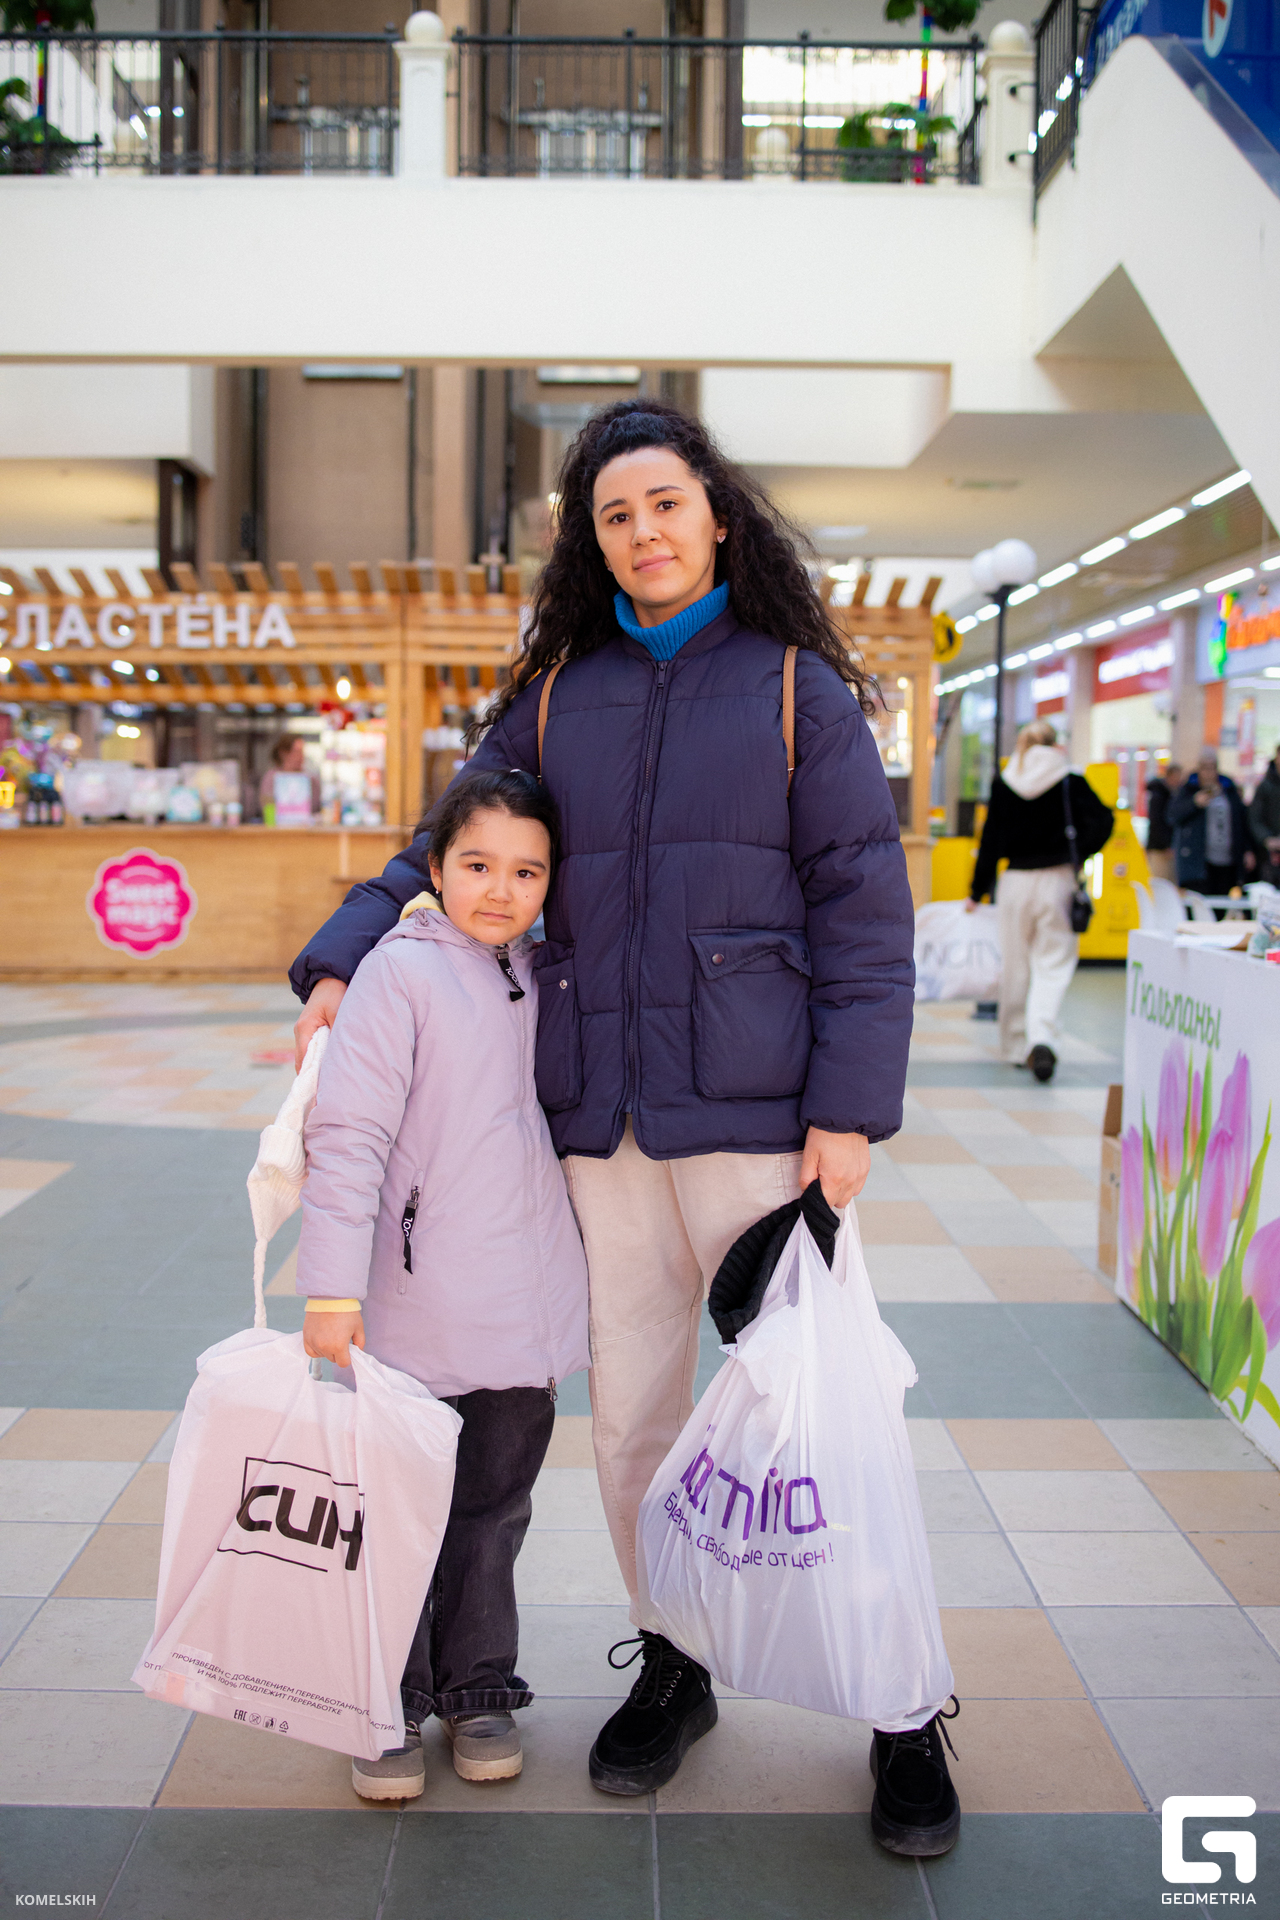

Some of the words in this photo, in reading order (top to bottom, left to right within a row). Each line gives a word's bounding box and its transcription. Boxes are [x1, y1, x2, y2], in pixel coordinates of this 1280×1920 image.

[0, 594, 297, 649] ЛАСТЁНА
[1131, 960, 1222, 1050] Тюльпаны
[768, 1552, 788, 1567] от
[171, 1652, 225, 1675] ПРОИЗВЕДЕН
[231, 1673, 295, 1694] ДОБАВЛЕНИЕМ
[197, 1668, 205, 1676] И
[205, 1671, 217, 1681] НА
[217, 1675, 238, 1688] 100%
[238, 1682, 287, 1699] ПОДЛЕЖИТ
[286, 1695, 343, 1716] ПЕРЕРАБОТКЕ
